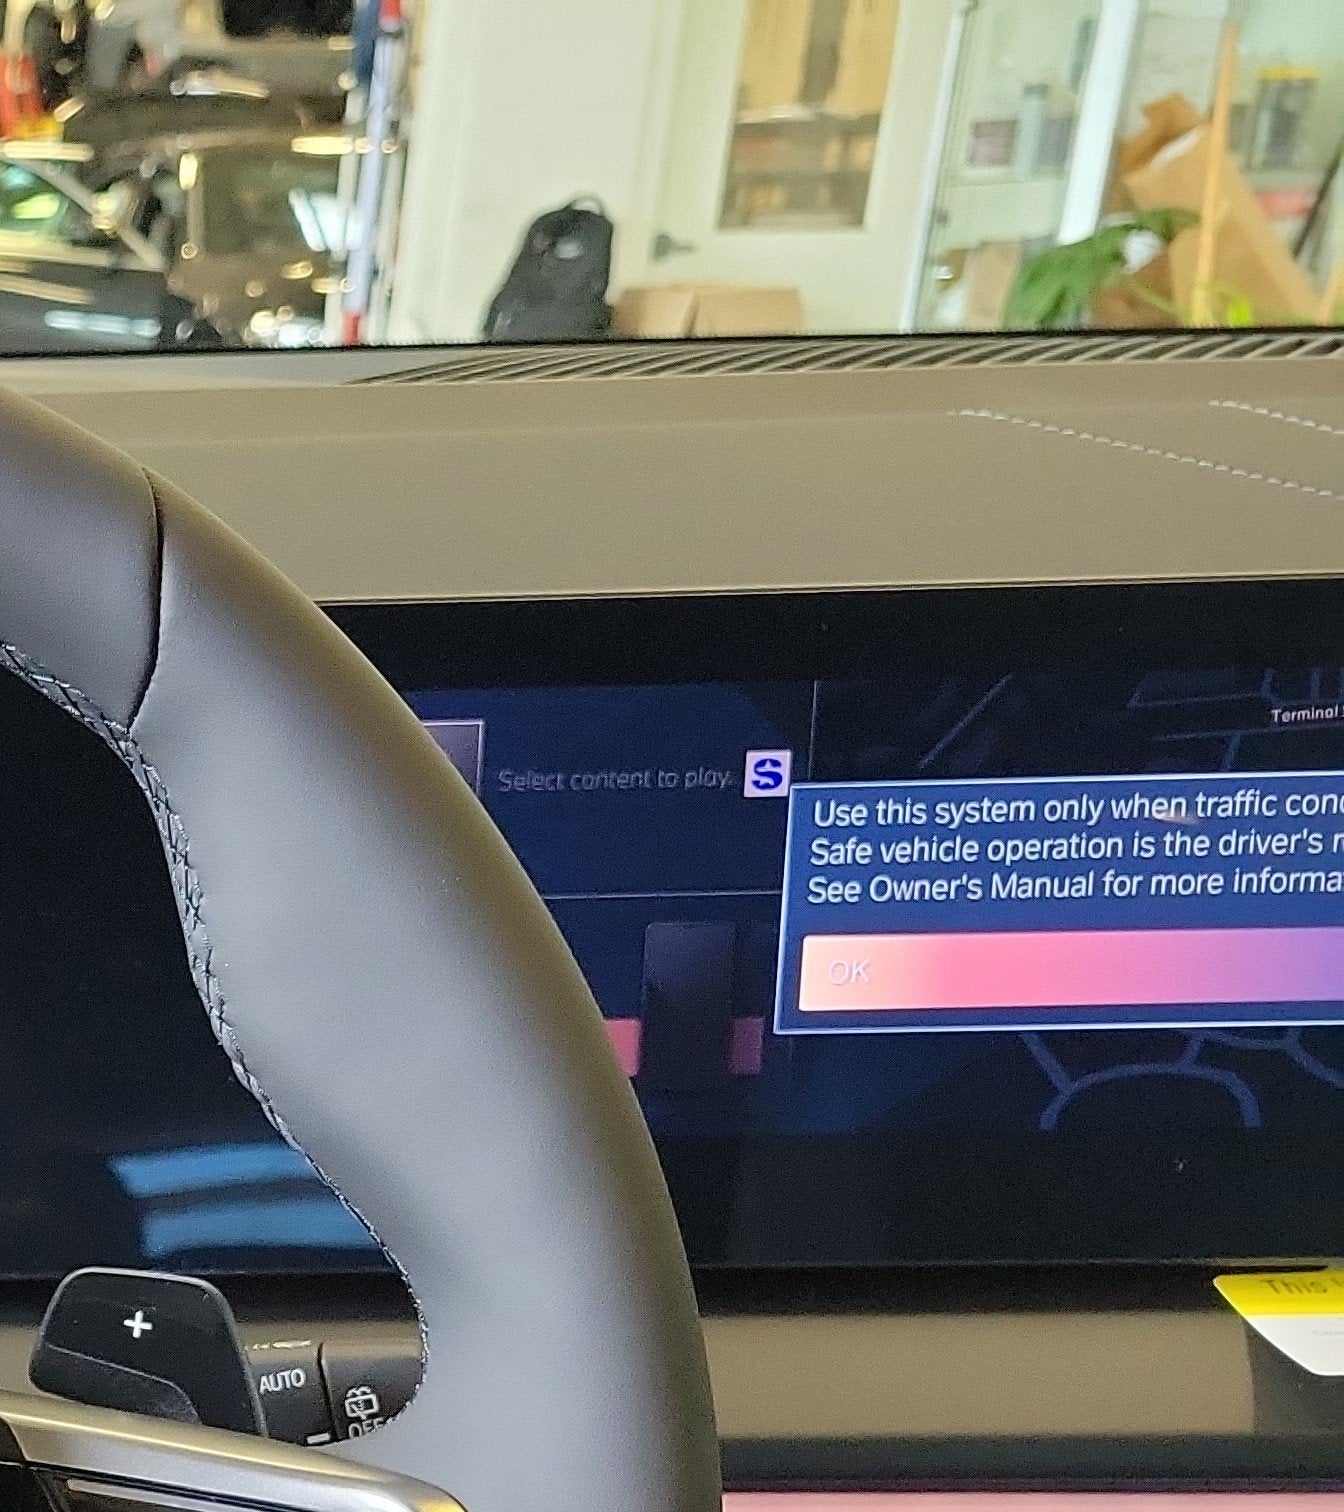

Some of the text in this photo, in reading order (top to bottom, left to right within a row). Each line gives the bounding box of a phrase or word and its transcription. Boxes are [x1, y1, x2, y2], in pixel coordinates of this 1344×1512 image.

[1271, 703, 1339, 723] Terminal
[498, 768, 563, 791] Select
[569, 768, 653, 791] content
[658, 767, 678, 788] to
[814, 799, 869, 828] Use
[875, 797, 928, 826] this
[934, 797, 1035, 829] system
[1044, 793, 1105, 826] only
[1111, 792, 1187, 820] when
[1195, 789, 1277, 818] traffic
[810, 836, 873, 866] Safe
[880, 834, 980, 864] vehicle
[987, 831, 1123, 867] operation
[1132, 830, 1155, 858] is
[1163, 830, 1210, 858] the
[1218, 828, 1323, 857] driver's
[807, 866, 1344, 903] See Owner's Manual for more informa
[828, 958, 872, 986] OK
[258, 1368, 306, 1395] AUTO
